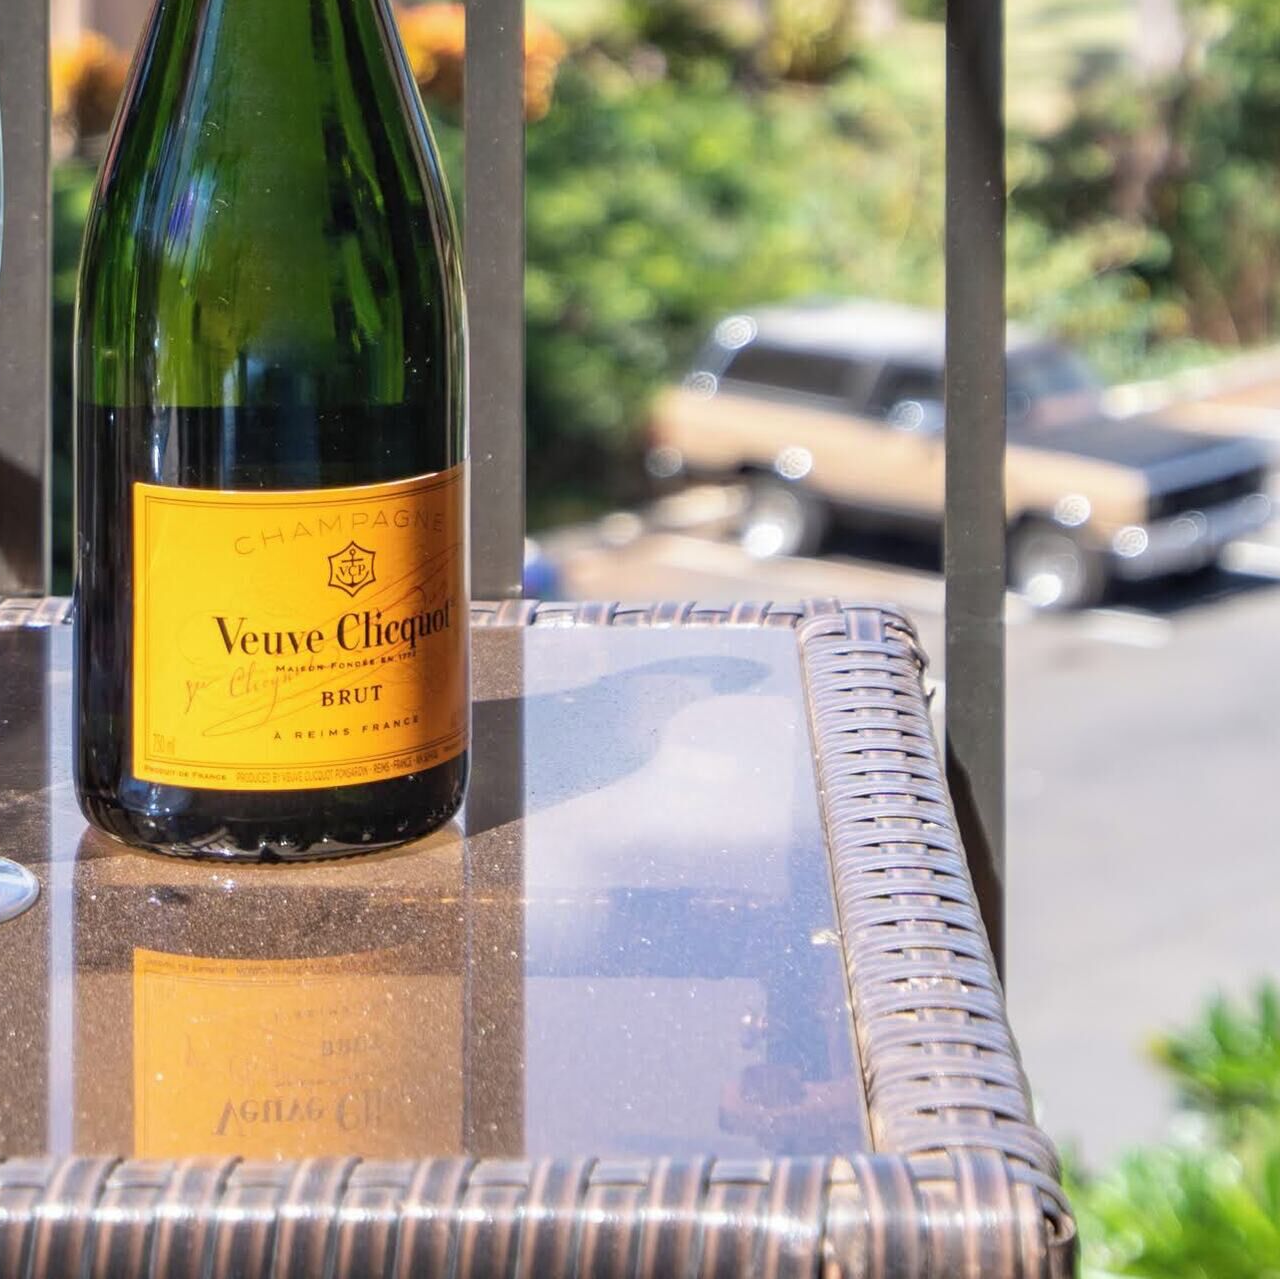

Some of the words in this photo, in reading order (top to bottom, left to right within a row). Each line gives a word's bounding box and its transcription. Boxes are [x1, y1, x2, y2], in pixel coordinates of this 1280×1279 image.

[234, 510, 445, 556] CHAMPAGNE
[338, 563, 366, 577] VCP
[212, 615, 325, 656] Veuve
[337, 599, 452, 651] Clicquot
[321, 684, 384, 707] BRUT
[294, 727, 352, 739] REIMS
[361, 714, 420, 734] FRANCE
